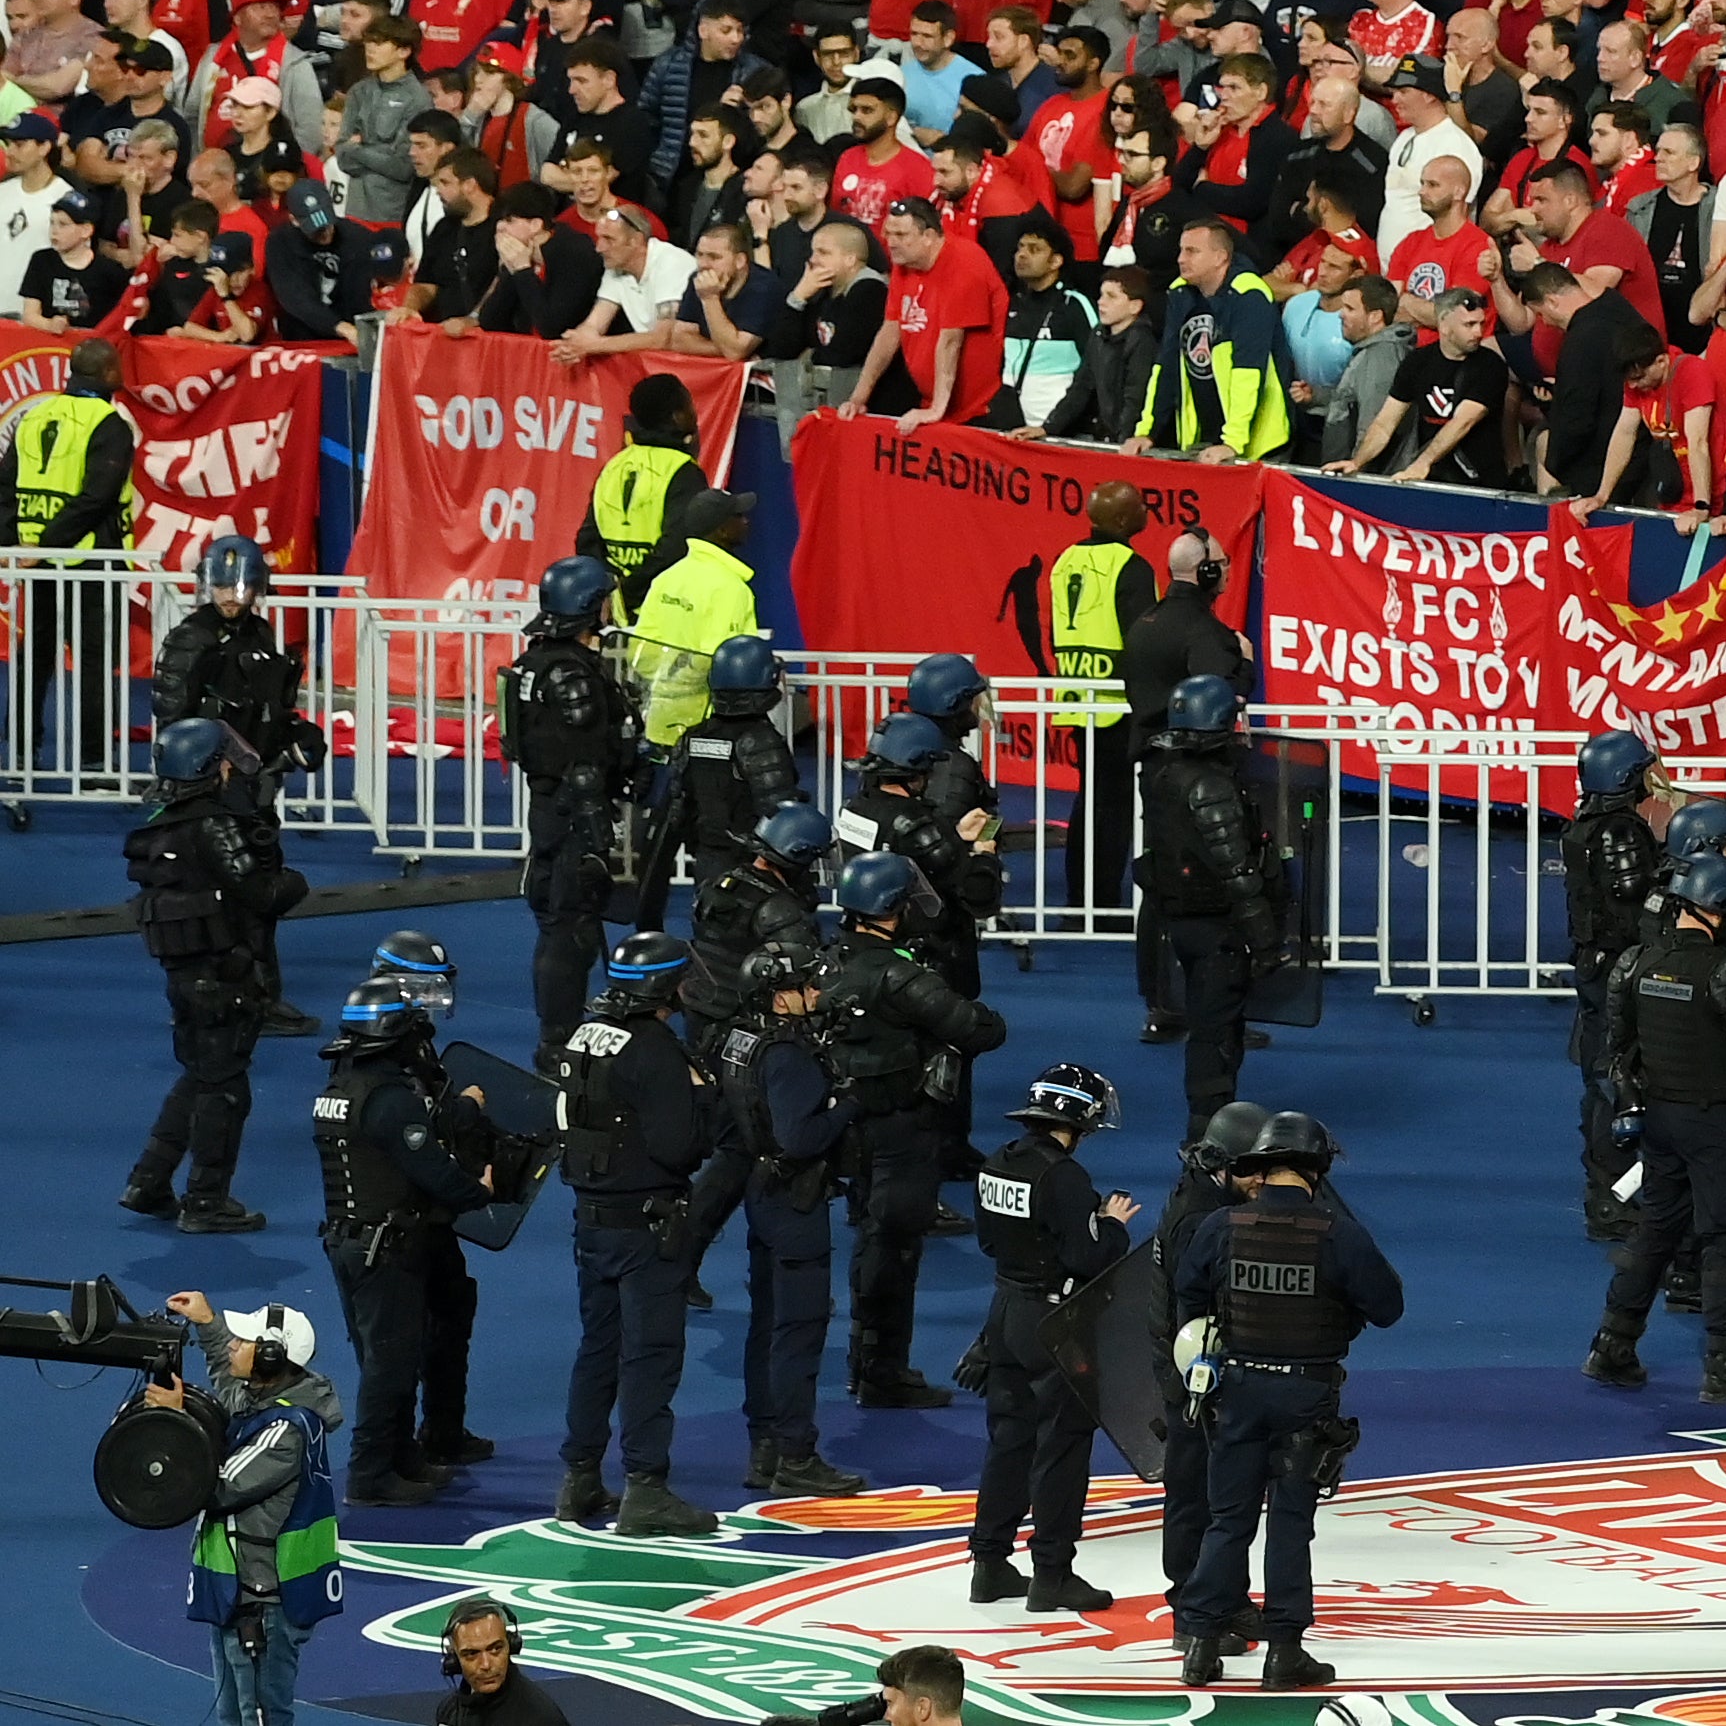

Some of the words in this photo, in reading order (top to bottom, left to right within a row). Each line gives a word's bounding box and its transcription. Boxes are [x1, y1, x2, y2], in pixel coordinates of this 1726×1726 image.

[415, 394, 504, 450] GOD
[514, 396, 604, 459] SAVE
[873, 434, 1030, 506] HEADING
[1041, 472, 1083, 515] TO
[1141, 485, 1202, 528] RIS
[480, 488, 537, 545] OR
[1291, 495, 1549, 590] LIVERPOO
[1413, 582, 1480, 641] FC
[1269, 615, 1438, 695] EXISTS
[1448, 647, 1509, 711] TO
[574, 1025, 625, 1054] POLICE
[312, 1096, 350, 1120] POLICE
[980, 1179, 1026, 1213] POLICE
[1234, 1264, 1311, 1293] POLICE
